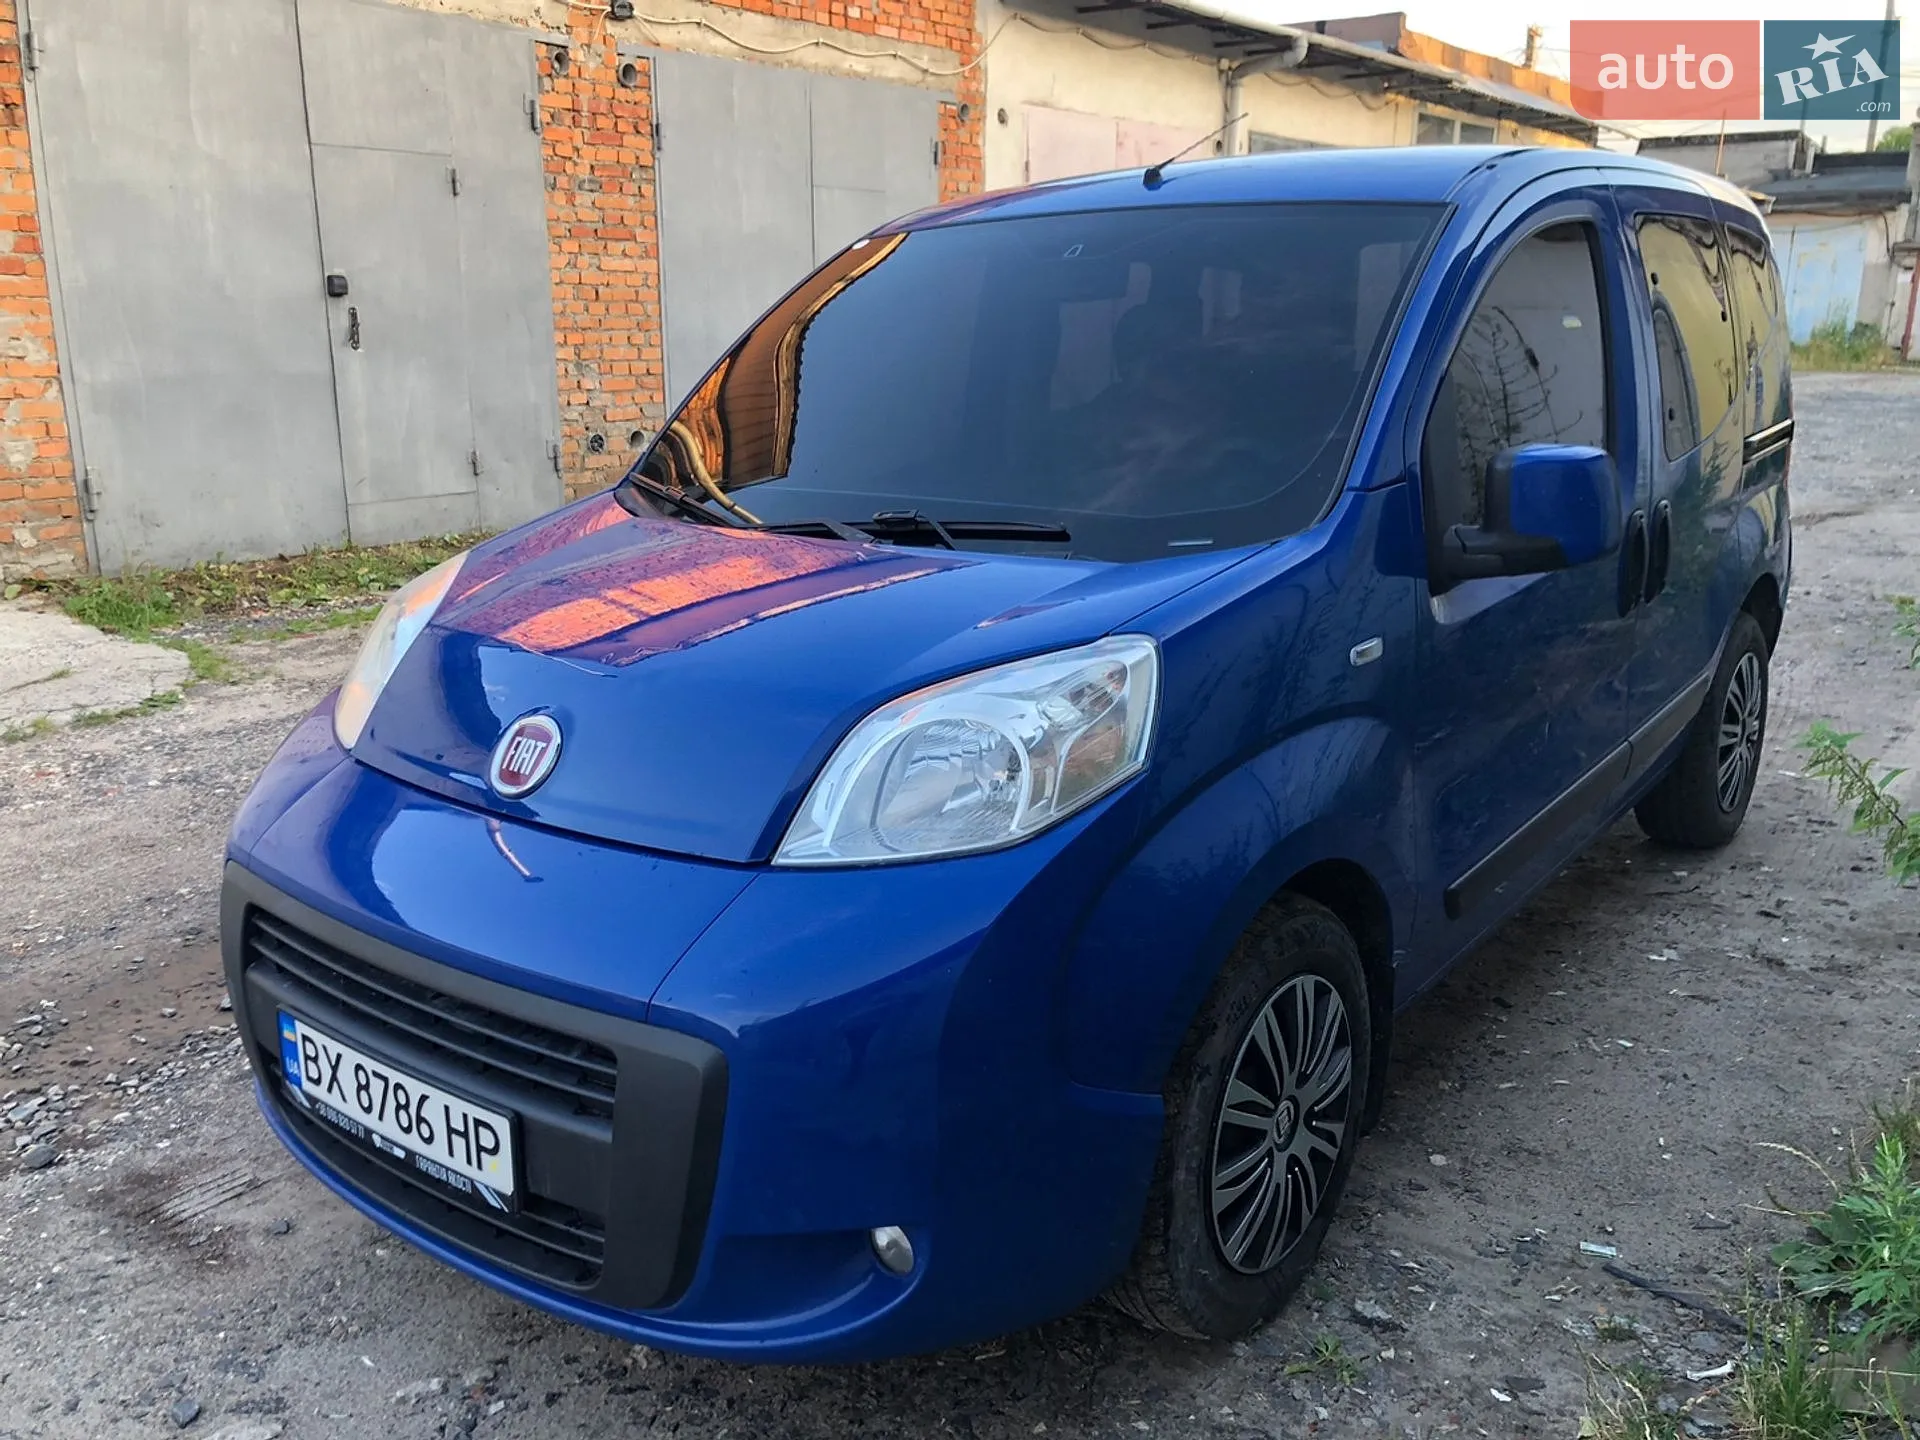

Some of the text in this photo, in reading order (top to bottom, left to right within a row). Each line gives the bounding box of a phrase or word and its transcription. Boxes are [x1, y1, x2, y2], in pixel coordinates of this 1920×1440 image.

[502, 736, 548, 776] FIAT
[301, 1033, 347, 1104] BX
[354, 1062, 435, 1145] 8786
[443, 1104, 500, 1172] HP
